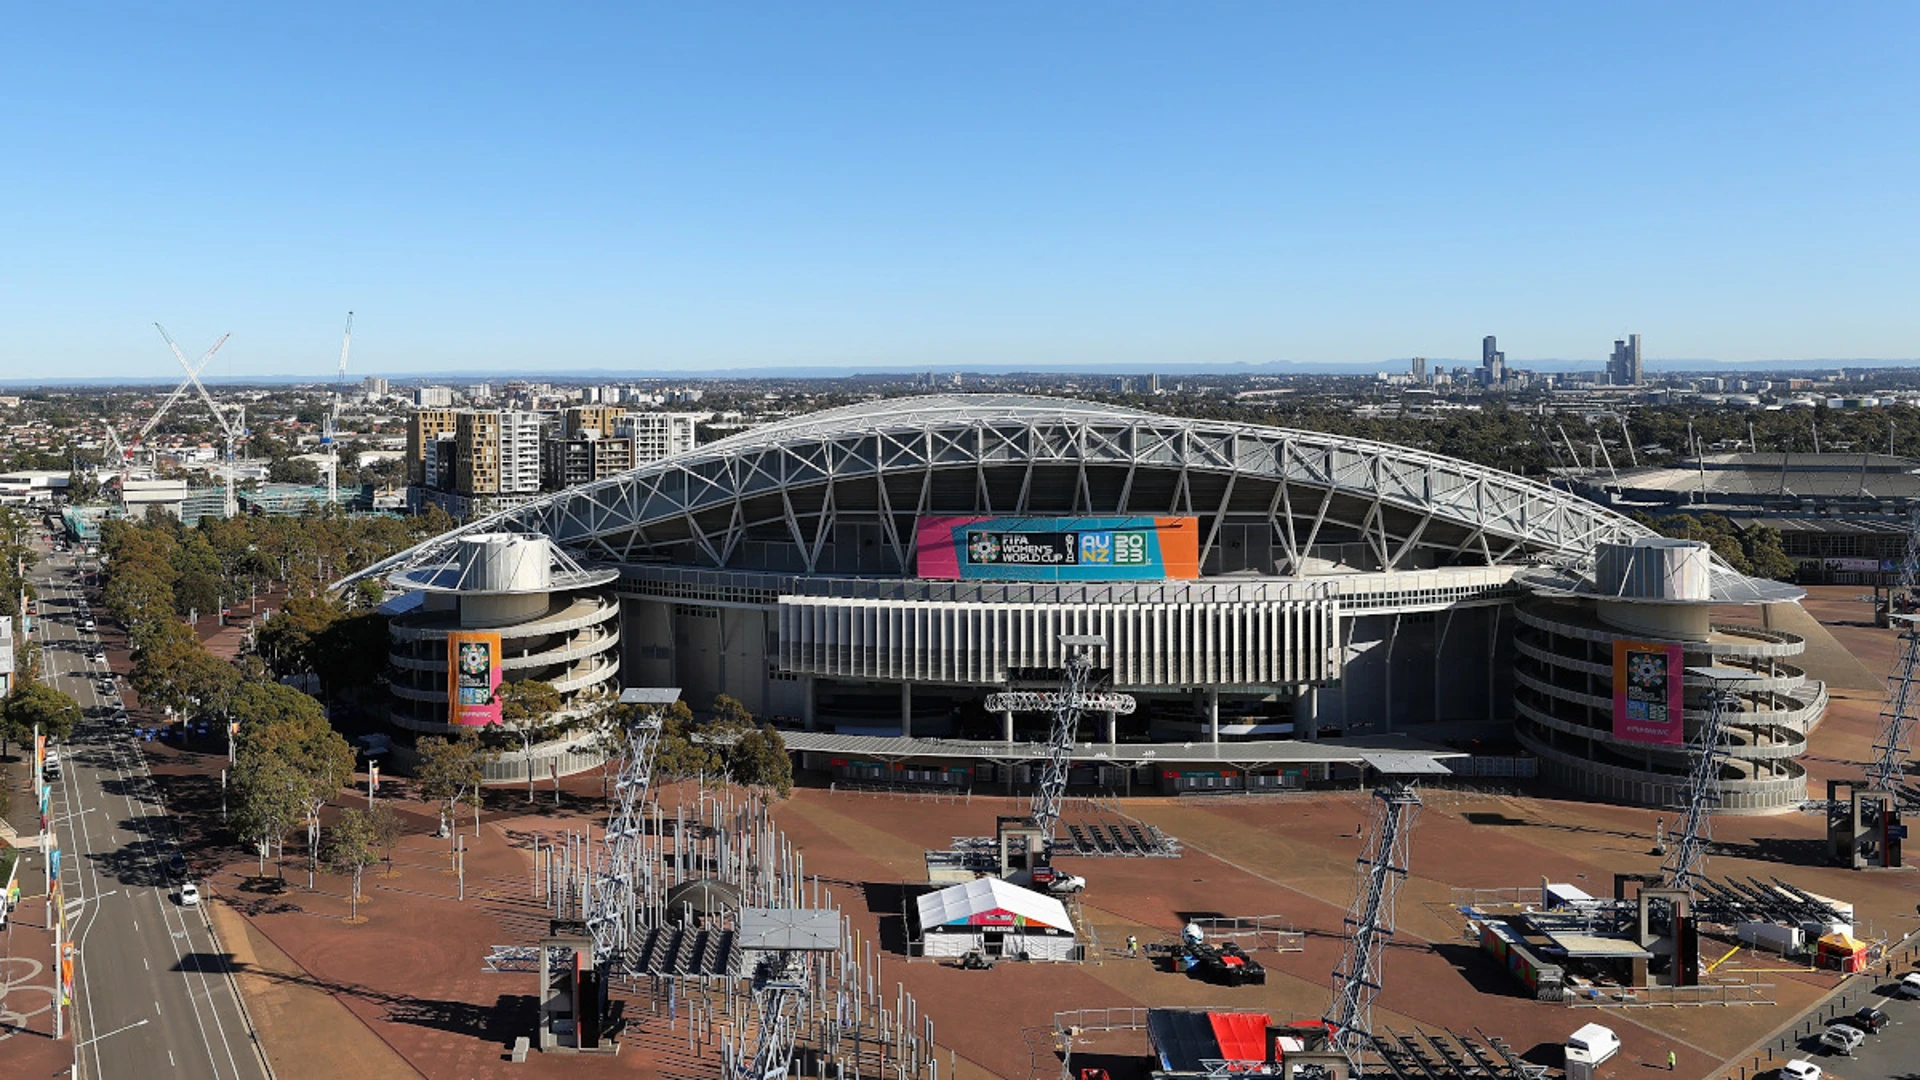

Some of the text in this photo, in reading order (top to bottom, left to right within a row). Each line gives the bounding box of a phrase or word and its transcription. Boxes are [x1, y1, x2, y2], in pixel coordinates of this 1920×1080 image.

[1002, 535, 1029, 545] FIFA
[1081, 535, 1110, 549] AU
[1114, 535, 1144, 549] 20
[1002, 545, 1053, 554] WOMEN'S
[1082, 549, 1110, 562] NZ
[1114, 549, 1144, 562] 23
[1002, 553, 1063, 563] WORLD CUP
